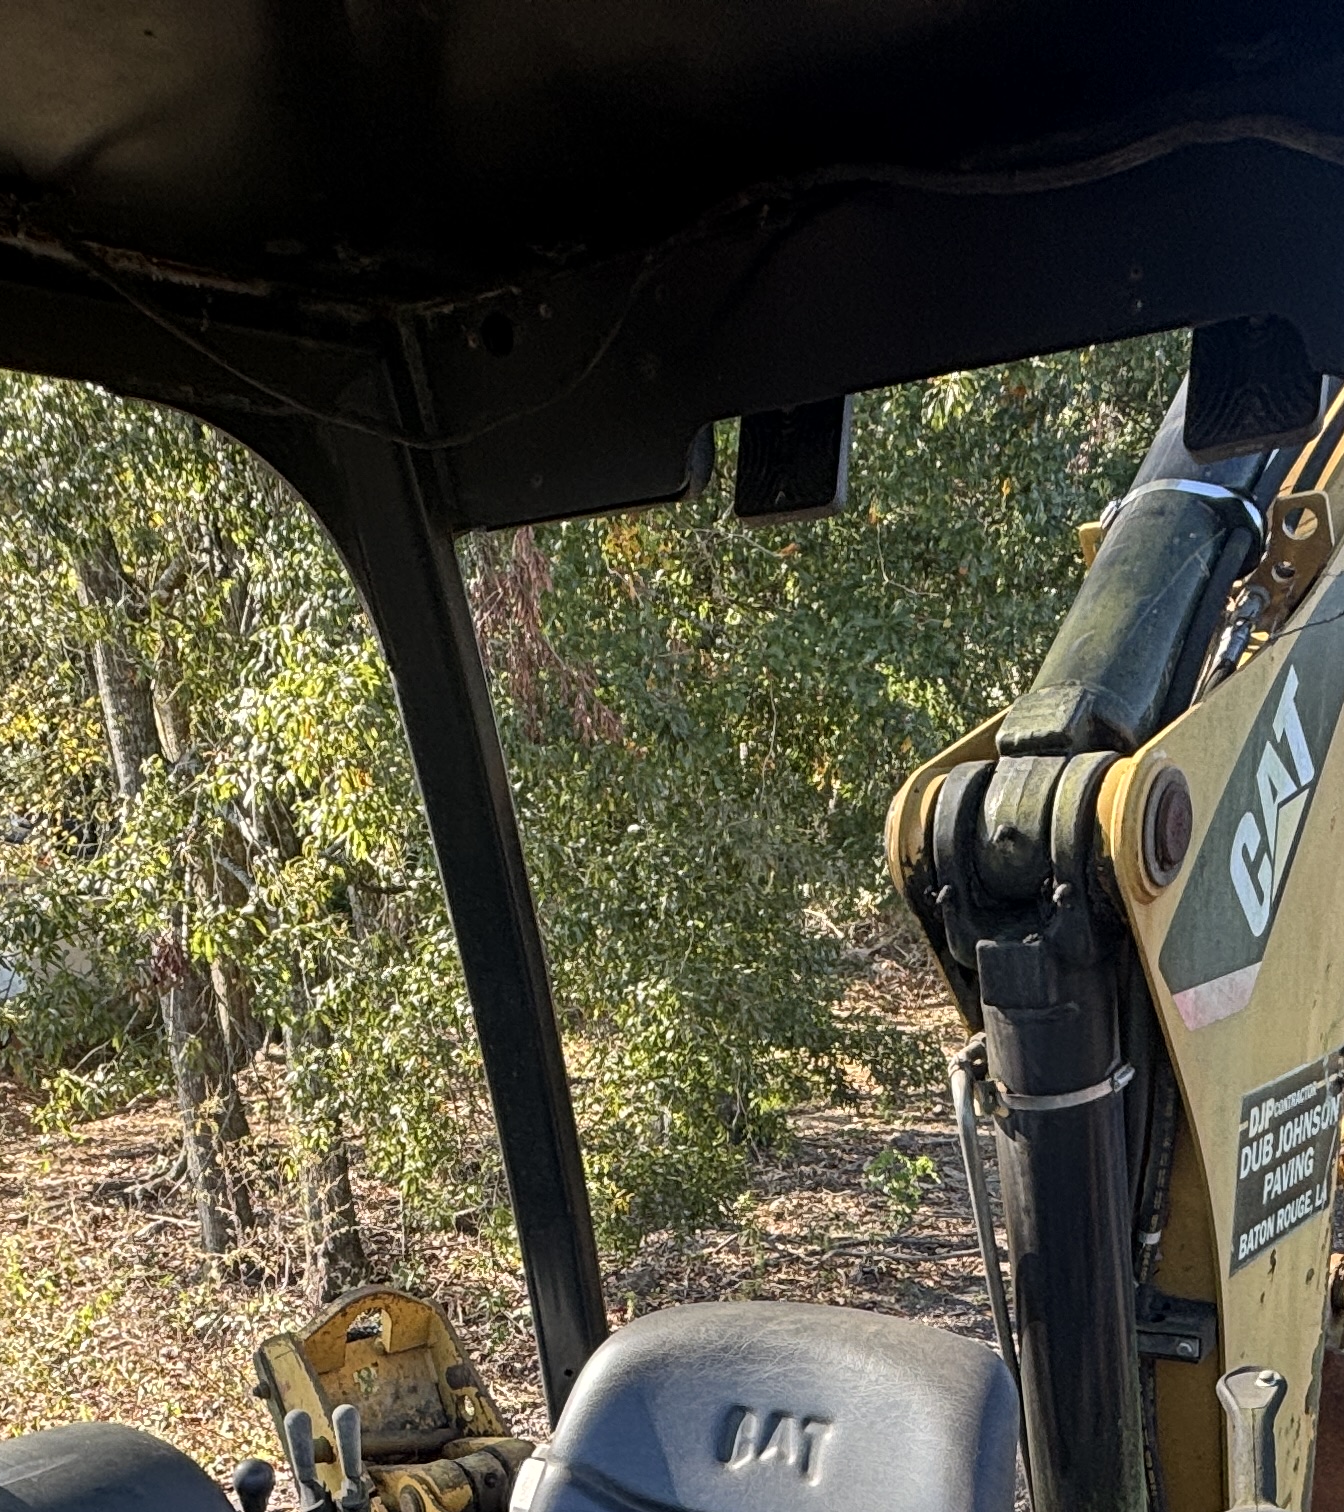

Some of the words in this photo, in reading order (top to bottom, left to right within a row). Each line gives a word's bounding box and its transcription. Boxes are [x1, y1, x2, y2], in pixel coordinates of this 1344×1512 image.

[1230, 664, 1315, 938] CAT
[1239, 1132, 1274, 1180] DUB
[1275, 1093, 1341, 1159] JOHNSON
[1249, 1098, 1275, 1139] DJP
[1262, 1146, 1315, 1205] PAVING
[1238, 1213, 1275, 1261] BATON
[1276, 1188, 1314, 1233] ROUGE,
[1315, 1182, 1328, 1208] LA
[716, 1404, 834, 1487] CAT
